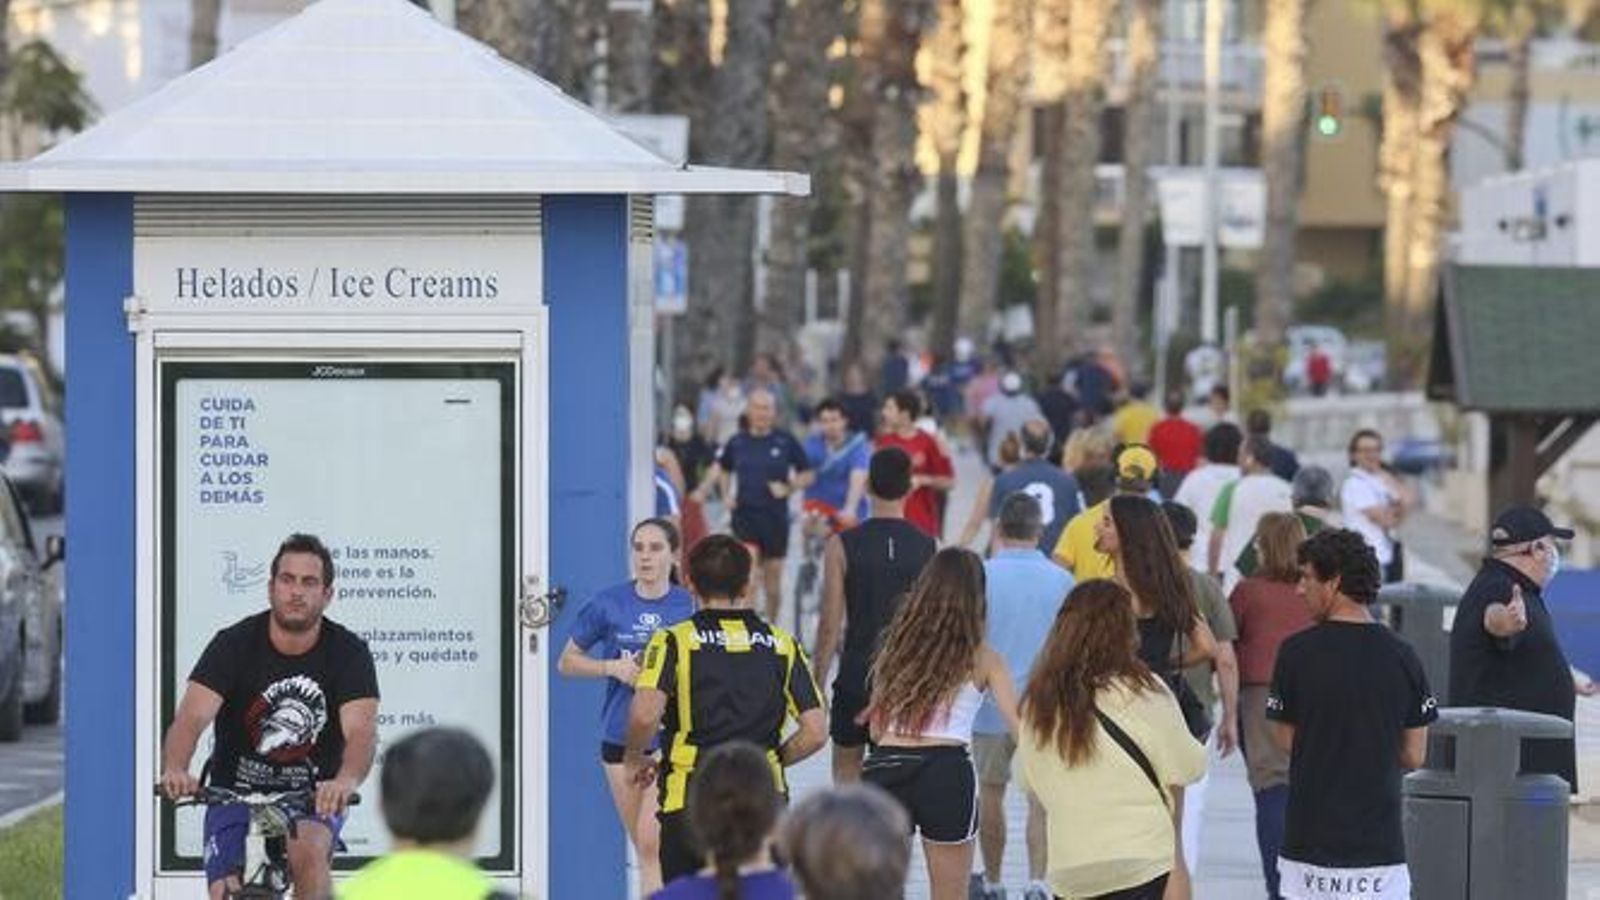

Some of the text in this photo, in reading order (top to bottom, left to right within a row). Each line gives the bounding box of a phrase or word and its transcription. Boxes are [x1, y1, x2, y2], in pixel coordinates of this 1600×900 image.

[176, 267, 499, 298] Helados / Ice Creams
[200, 398, 256, 411] CUIDA
[200, 416, 246, 430] DE TI
[200, 435, 250, 448] PARA
[200, 453, 269, 466] CUIDAR
[200, 471, 254, 485] A LOS
[200, 486, 265, 504] DEMÁS
[345, 546, 370, 560] las
[373, 548, 435, 560] manos.
[376, 567, 396, 579] es
[400, 565, 415, 579] la
[338, 583, 437, 600] prevención.
[361, 628, 475, 644] plazamientos
[394, 651, 405, 664] y
[408, 647, 479, 665] quédate
[401, 709, 437, 726] más
[1304, 871, 1383, 893] VENICE
